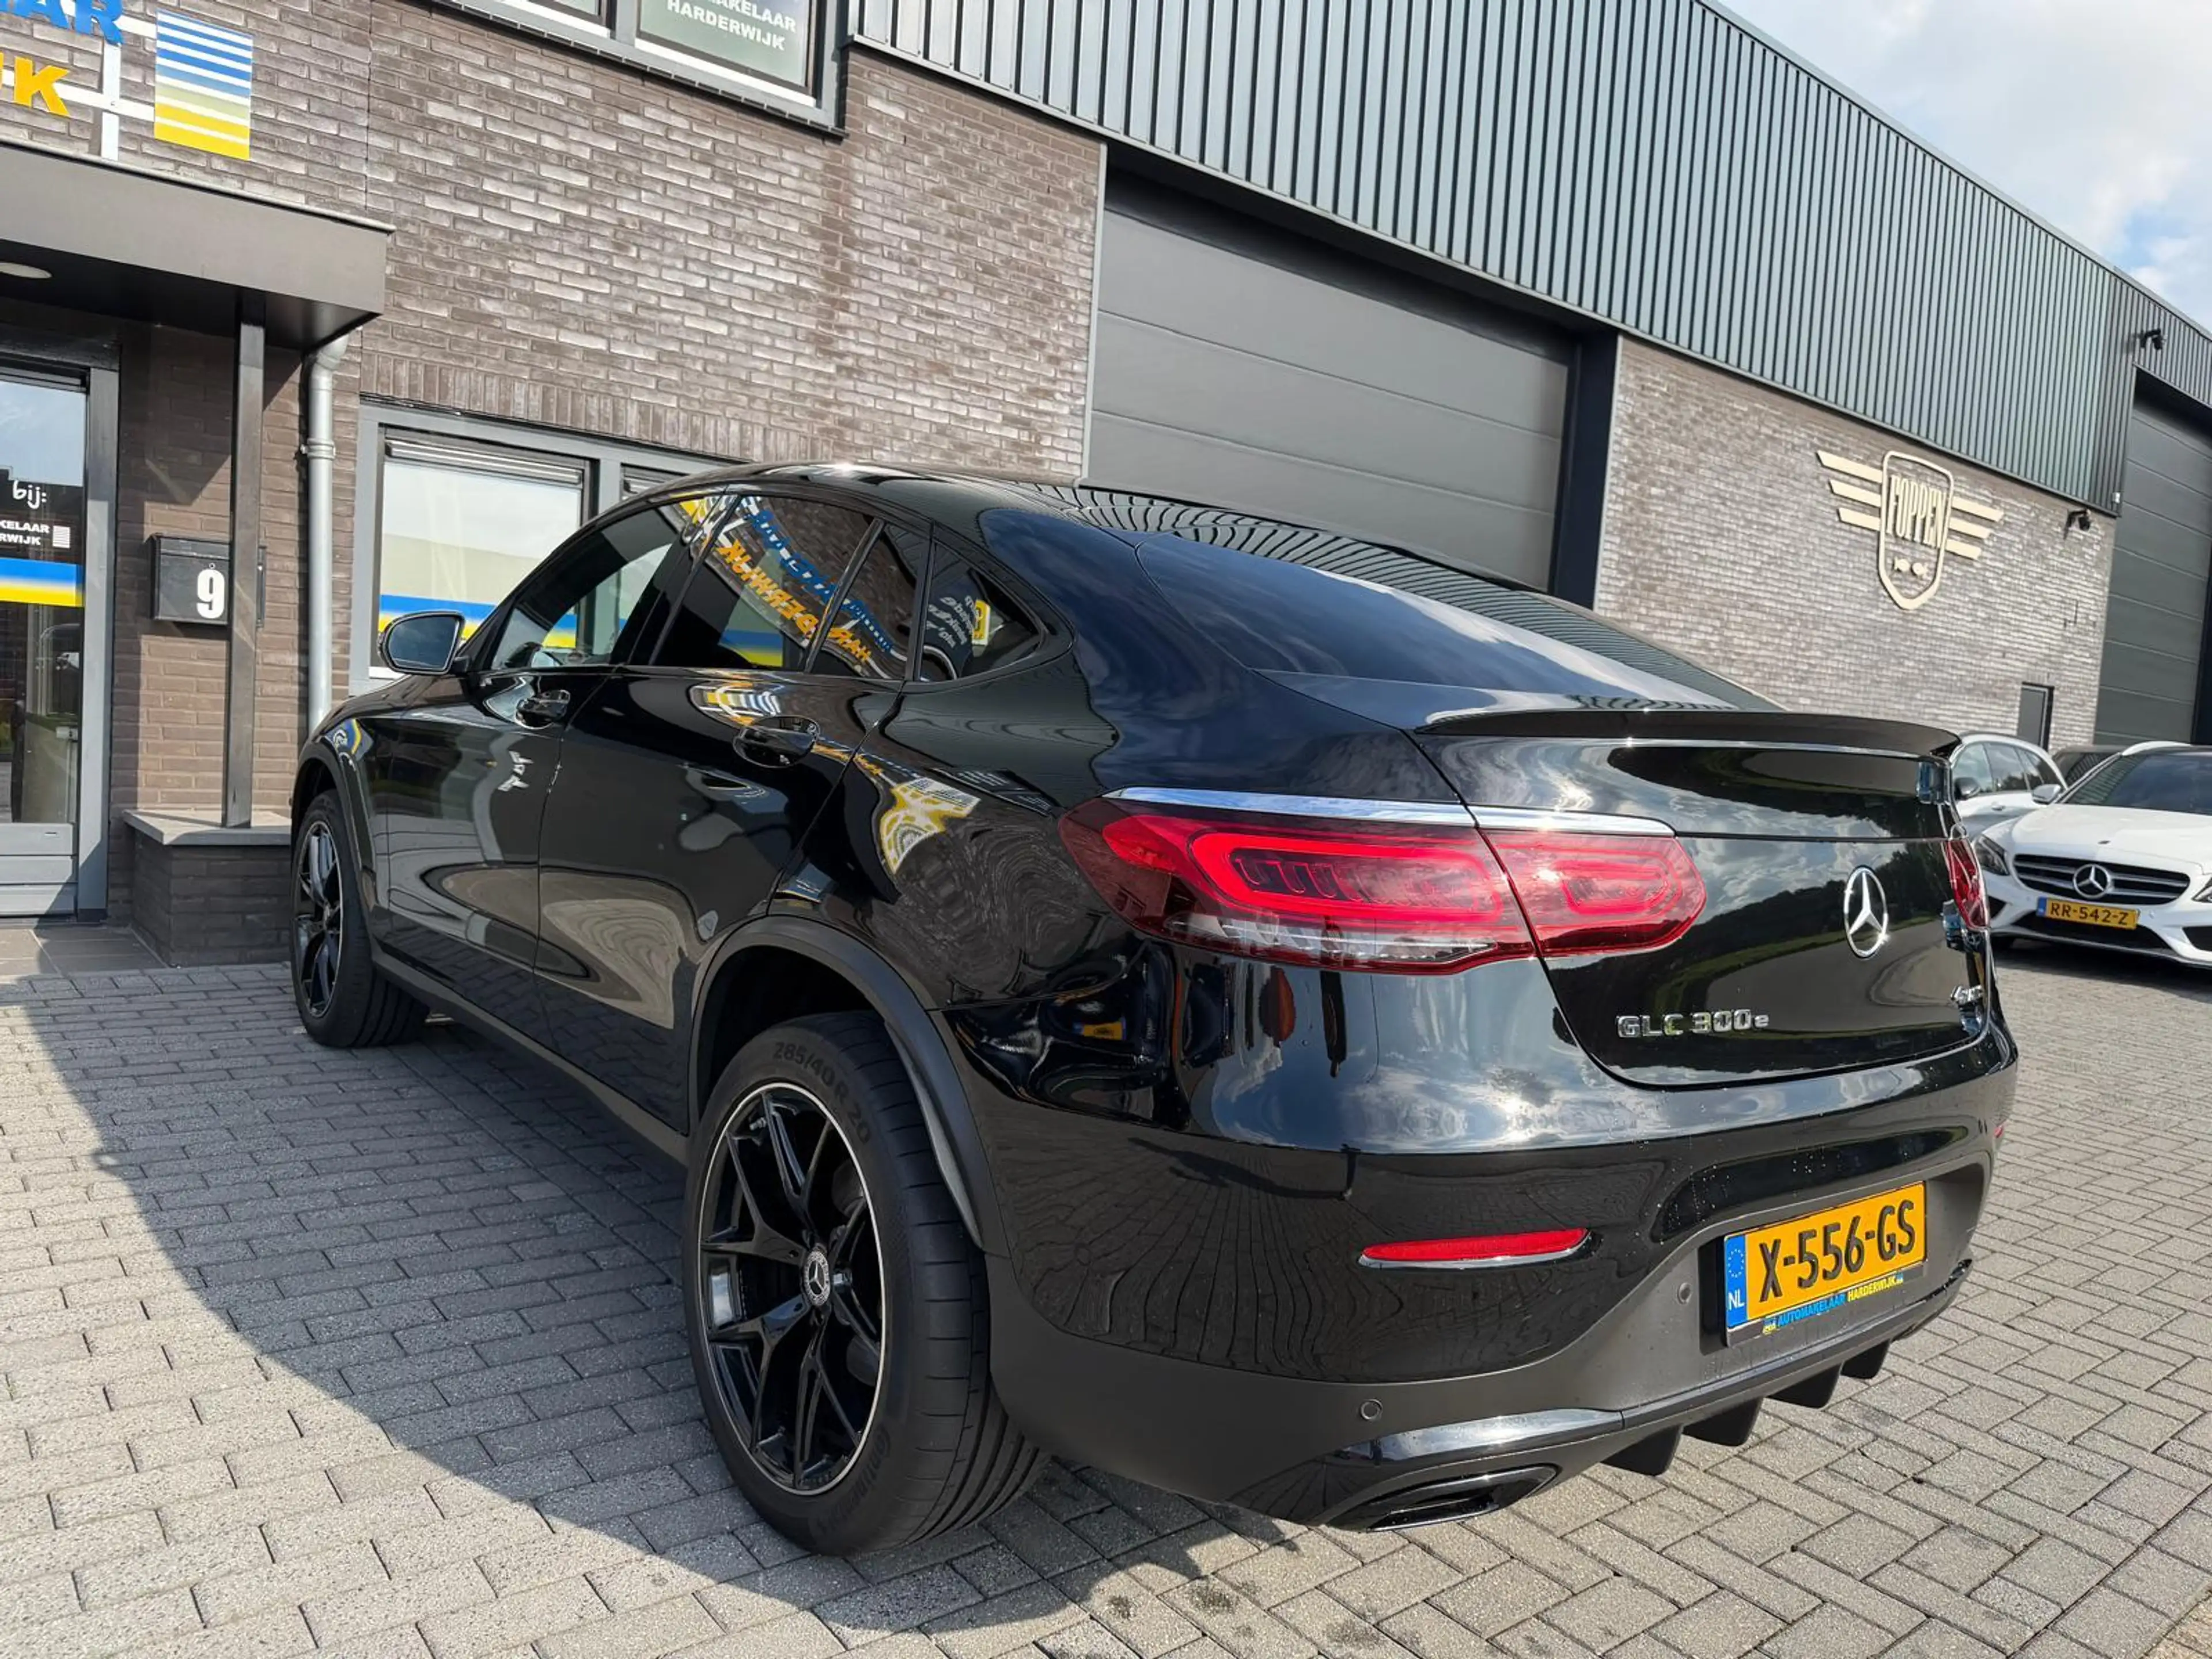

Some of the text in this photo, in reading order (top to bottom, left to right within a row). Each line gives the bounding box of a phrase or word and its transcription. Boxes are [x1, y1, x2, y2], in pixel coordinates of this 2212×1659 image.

[667, 0, 786, 51] HARDERWIJK
[0, 51, 70, 117] K
[12, 480, 47, 509] bij:
[1886, 474, 1947, 549] FOPPEN
[197, 569, 225, 619] 9
[2050, 903, 2128, 926] RR-542-Z
[1616, 1009, 1769, 1037] GLC 300e
[773, 1041, 871, 1144] 285/40 R 20
[1759, 1199, 1916, 1303] X-556-GS
[1727, 1289, 1745, 1310] NL
[1847, 1274, 1897, 1302] HARDERWIJK
